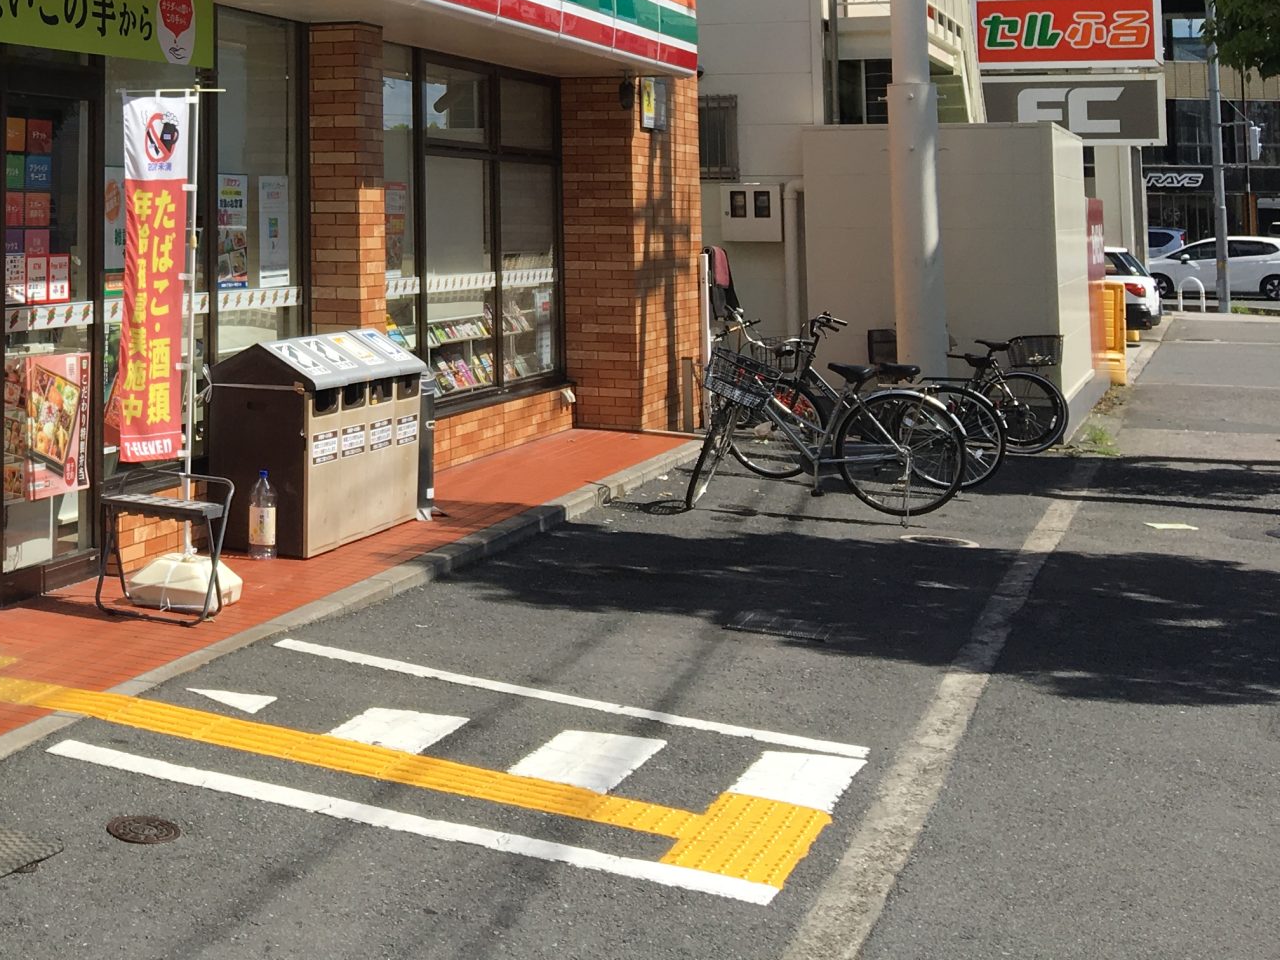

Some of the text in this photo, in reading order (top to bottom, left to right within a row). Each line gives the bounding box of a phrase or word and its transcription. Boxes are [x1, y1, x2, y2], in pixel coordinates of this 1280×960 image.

[981, 10, 1151, 50] セルふる
[1018, 87, 1125, 133] FC
[1146, 165, 1204, 187] RAYS
[146, 189, 176, 426] たばこ・酒類
